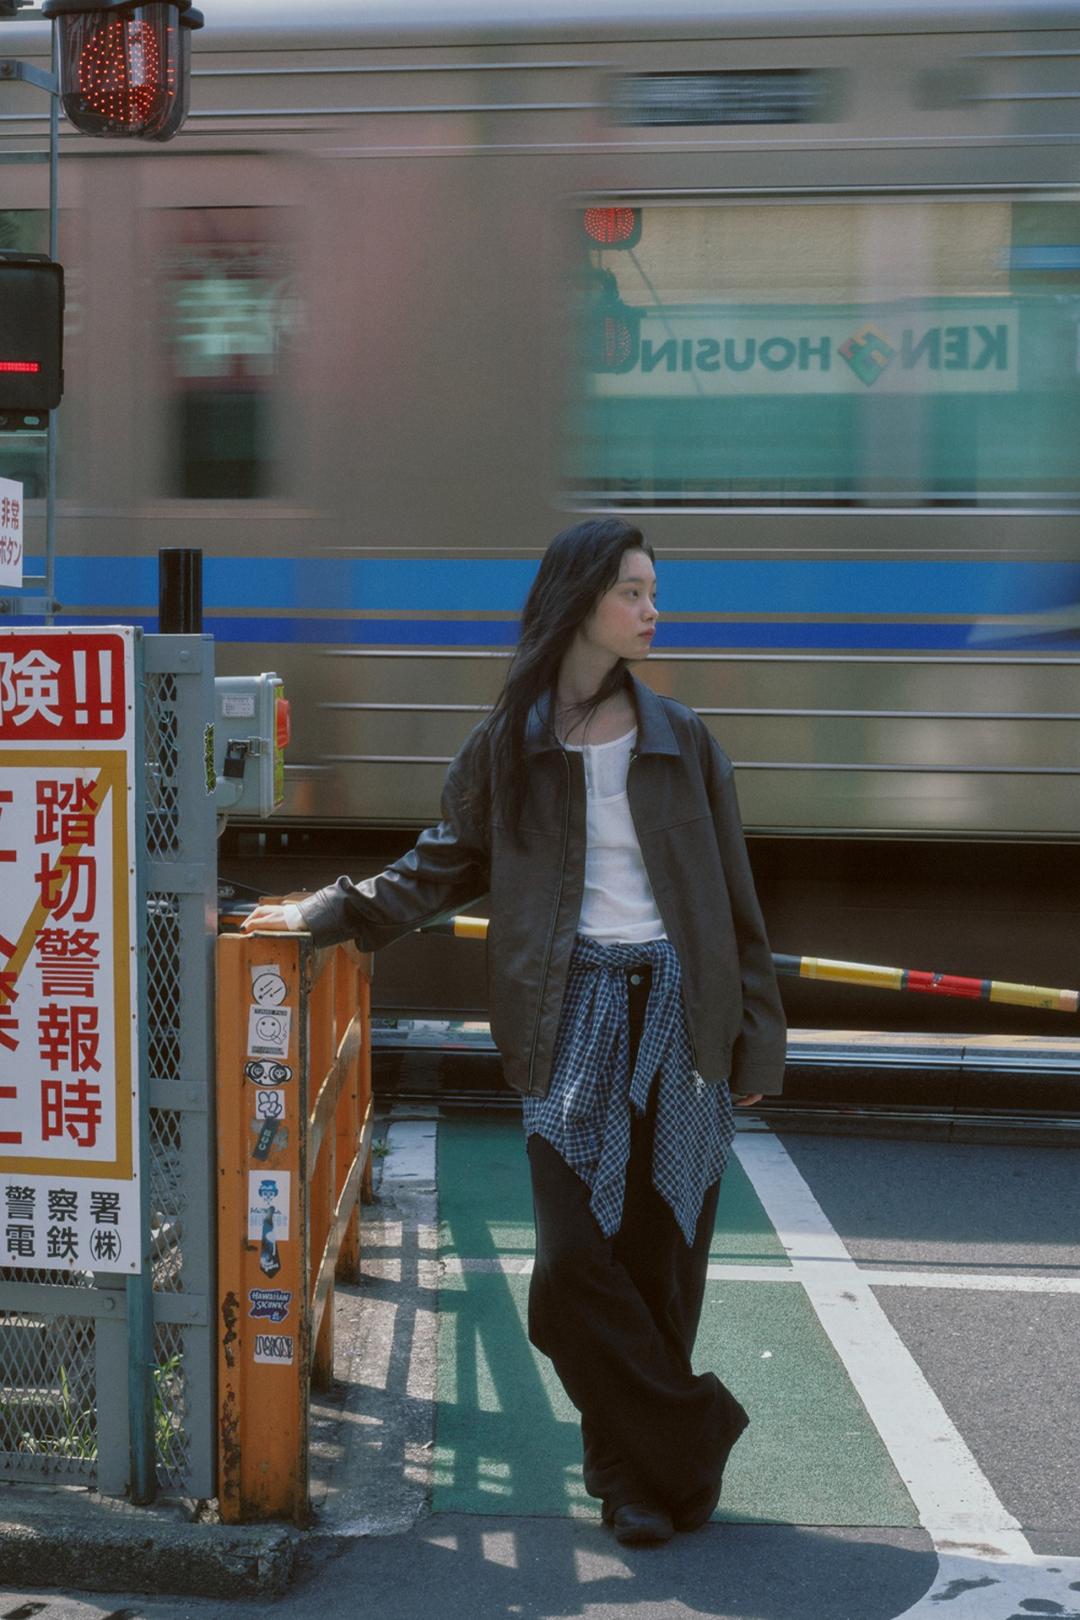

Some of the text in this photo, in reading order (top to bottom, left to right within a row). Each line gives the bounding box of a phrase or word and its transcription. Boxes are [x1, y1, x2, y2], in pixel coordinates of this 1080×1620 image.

[34, 778, 102, 1147] 踏切警報時
[5, 1186, 120, 1225] 警察署
